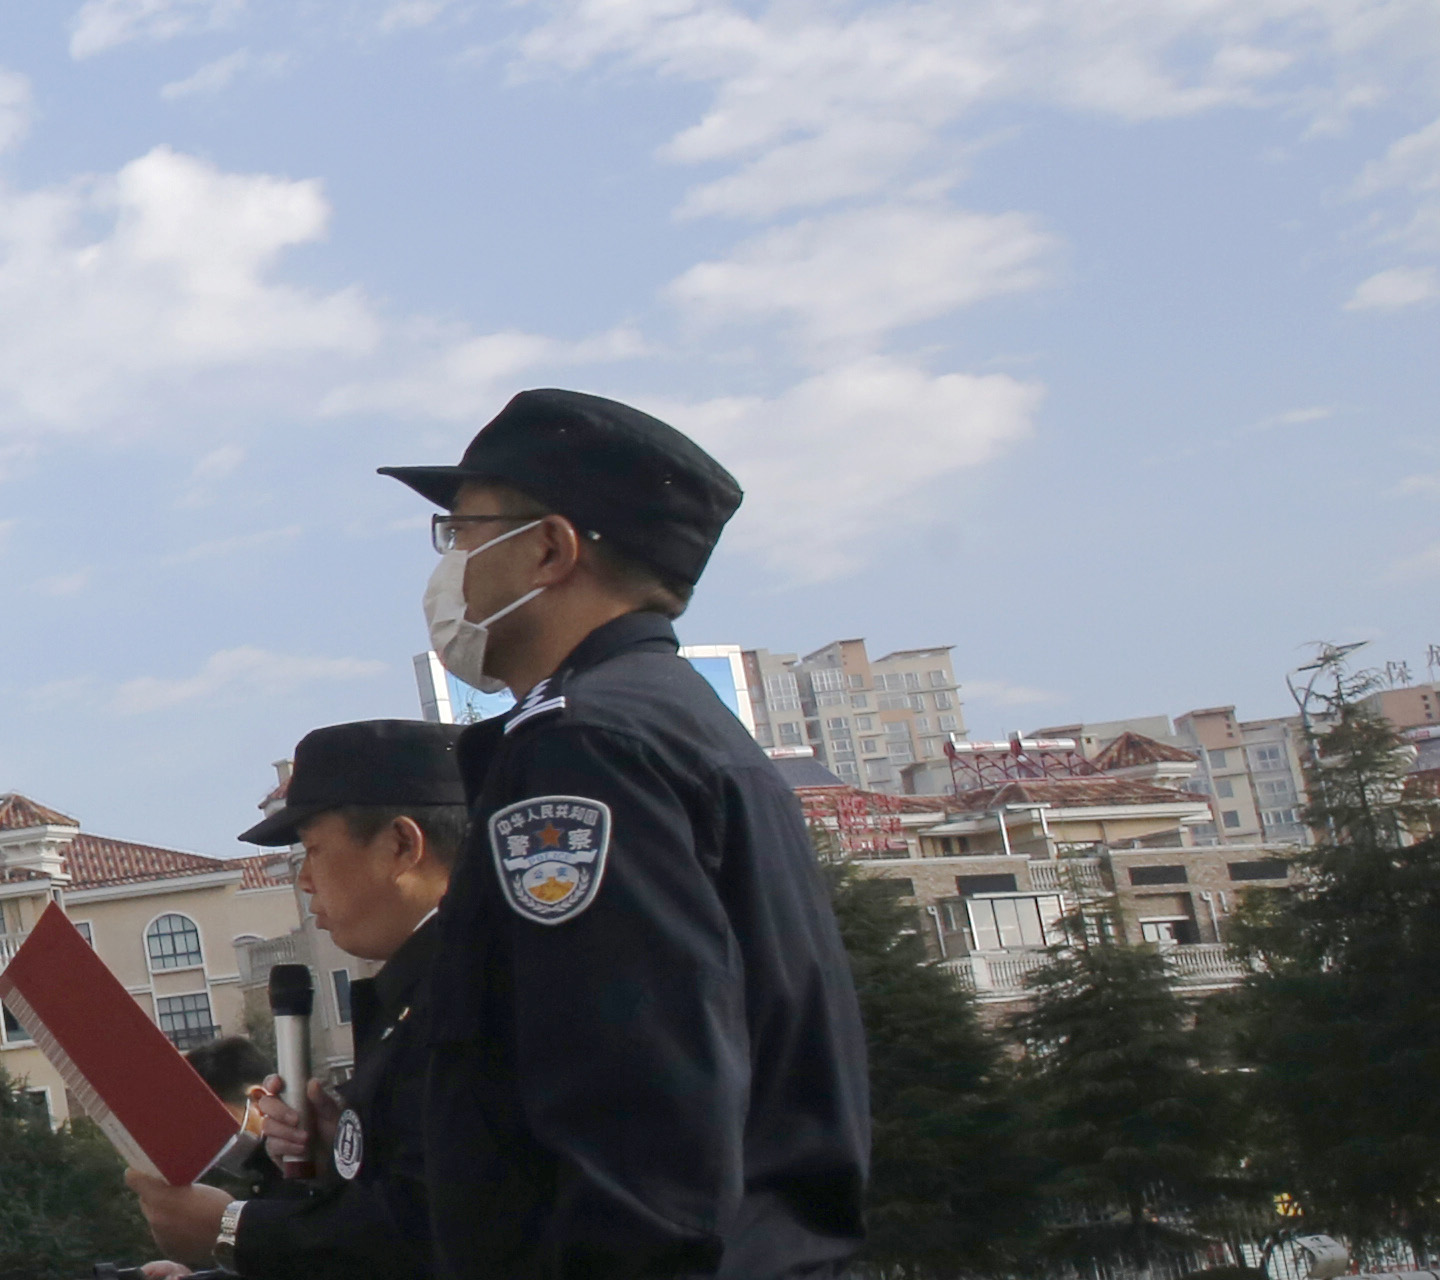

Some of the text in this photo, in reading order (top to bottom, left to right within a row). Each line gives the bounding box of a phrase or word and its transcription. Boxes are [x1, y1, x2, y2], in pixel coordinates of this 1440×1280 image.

[497, 804, 599, 836] 中华人民共和国
